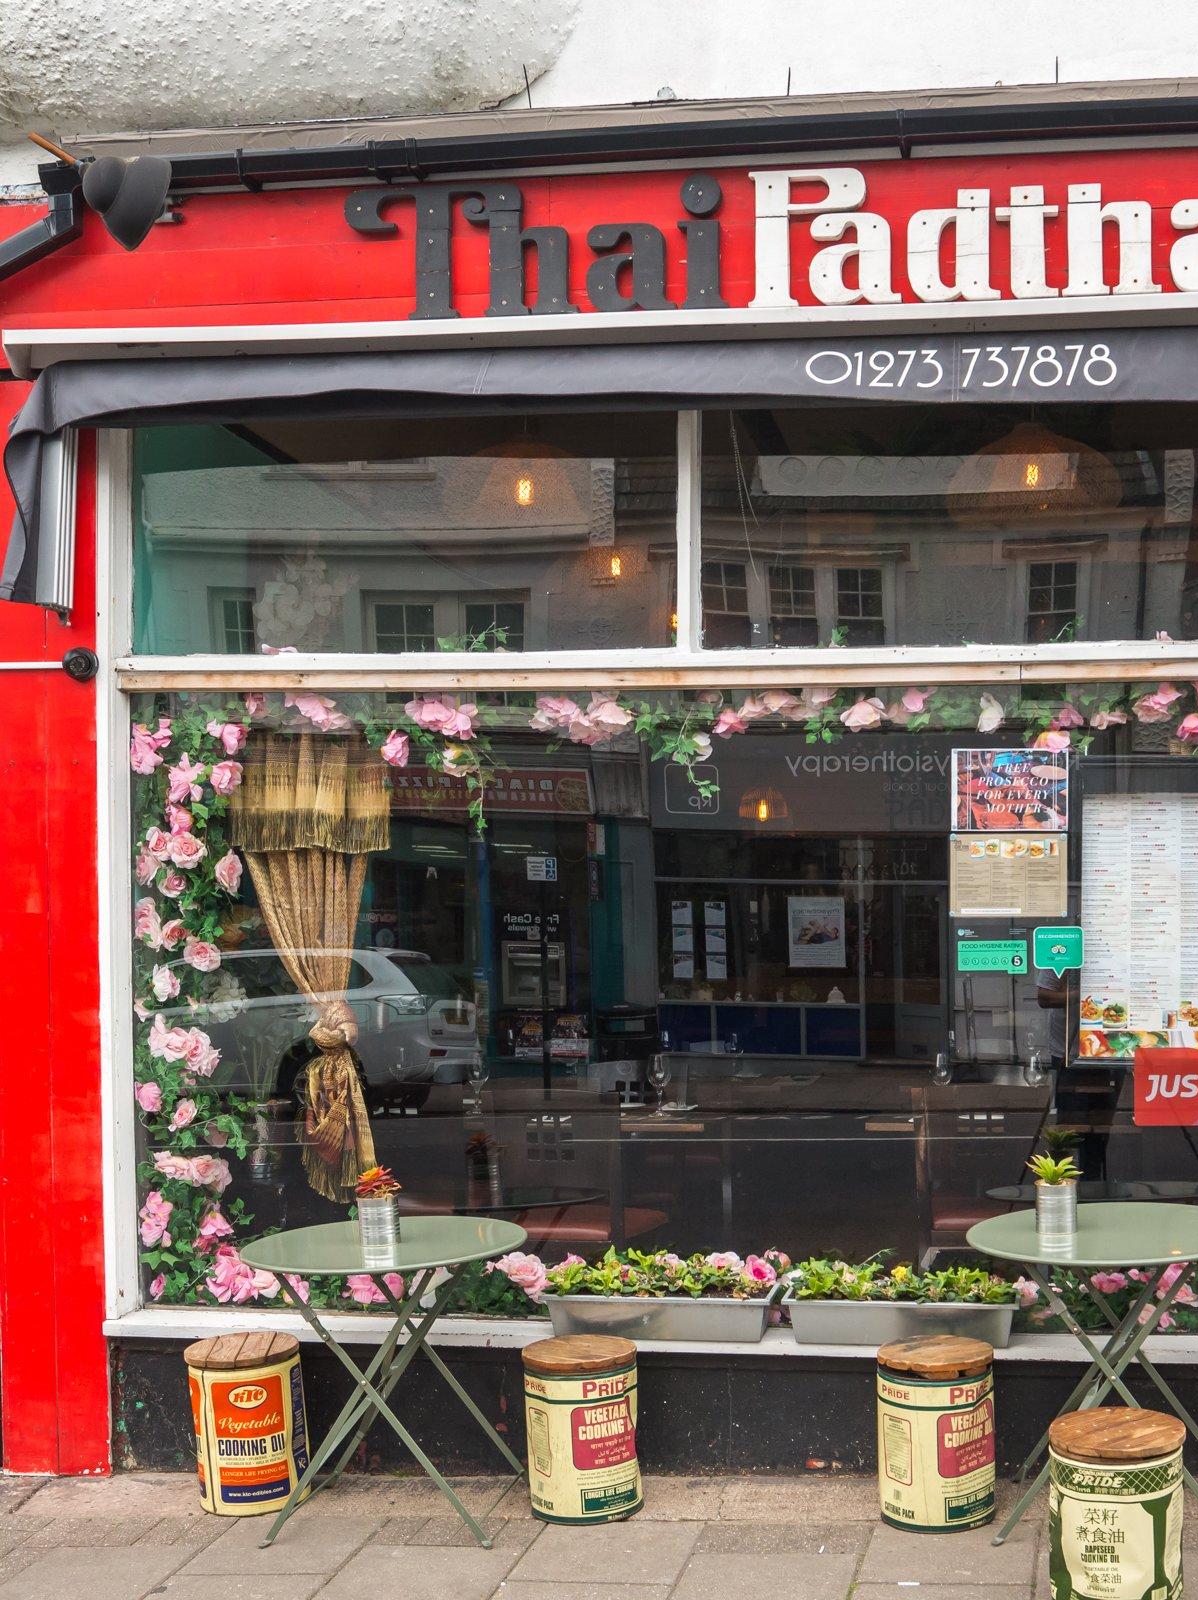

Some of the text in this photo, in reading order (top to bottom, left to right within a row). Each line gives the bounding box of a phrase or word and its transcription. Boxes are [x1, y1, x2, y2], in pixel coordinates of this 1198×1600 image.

[345, 173, 725, 320] Thai
[804, 343, 1118, 389] 01273 737878
[997, 762, 1031, 773] FREE
[977, 776, 1049, 787] PROSECCO
[976, 789, 1050, 800] FOR EVERY
[985, 803, 1042, 813] MOTHER
[232, 1386, 265, 1404] KTC
[524, 1380, 547, 1394] PRIDE
[582, 1377, 628, 1399] PRIDE
[882, 1384, 910, 1401] PRIDE
[949, 1380, 989, 1404] PRIDE
[218, 1413, 281, 1434] Vegetable
[950, 1404, 989, 1431] VEGETABLE
[578, 1419, 625, 1441] COOKING
[944, 1424, 983, 1448] COOKING
[217, 1438, 267, 1457] COOKING
[257, 1467, 278, 1476] FRYING
[1072, 1473, 1126, 1488] PRIDE
[901, 1508, 915, 1520] PACK
[1083, 1507, 1119, 1526] 菜籽
[1075, 1525, 1125, 1544] 煮食油
[1080, 1553, 1120, 1563] COOKING OIL
[1084, 1544, 1116, 1554] RAPESEED
